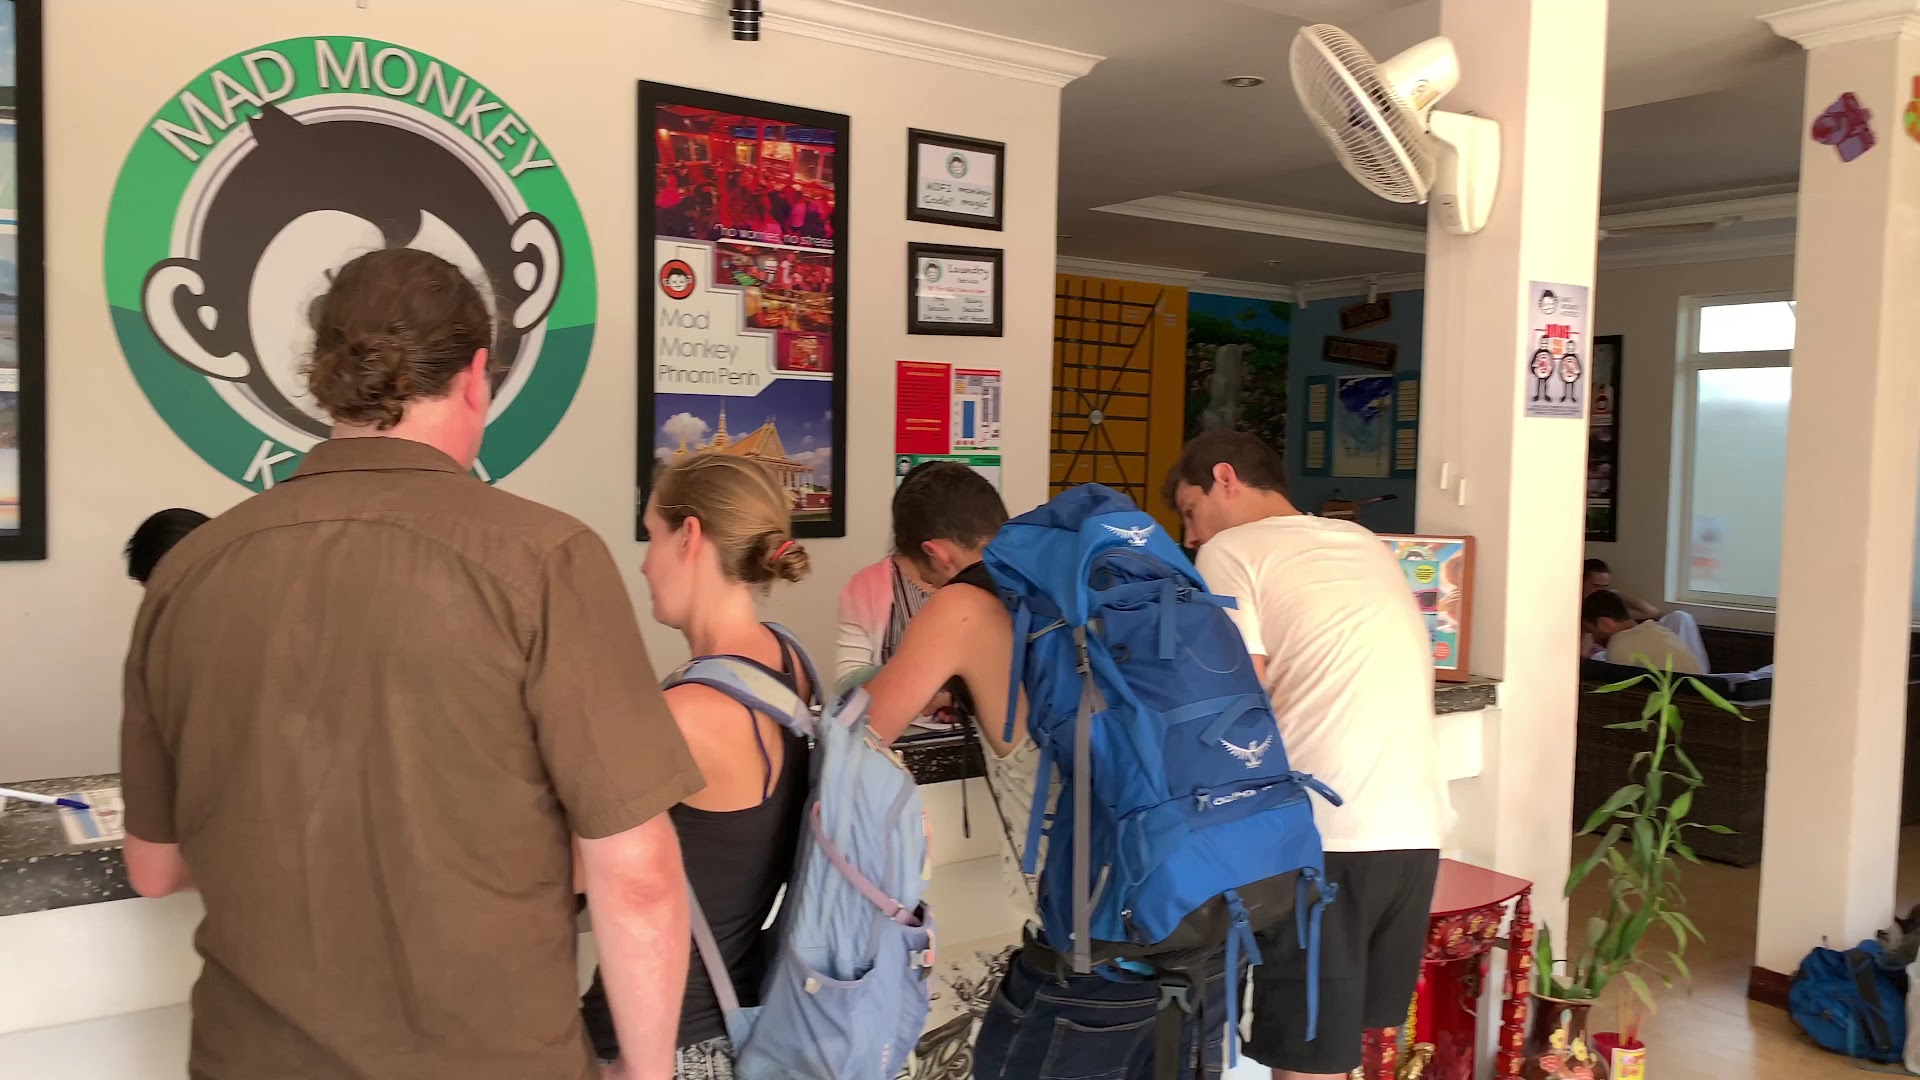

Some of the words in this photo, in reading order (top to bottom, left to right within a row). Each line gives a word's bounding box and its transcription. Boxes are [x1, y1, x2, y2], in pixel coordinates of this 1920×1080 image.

[150, 49, 296, 163] MAD
[313, 39, 555, 179] MONKEY
[947, 263, 990, 281] Laundry
[660, 307, 711, 330] Mad
[660, 336, 740, 365] Monkey
[659, 364, 717, 384] Phnom
[718, 367, 760, 386] Penh
